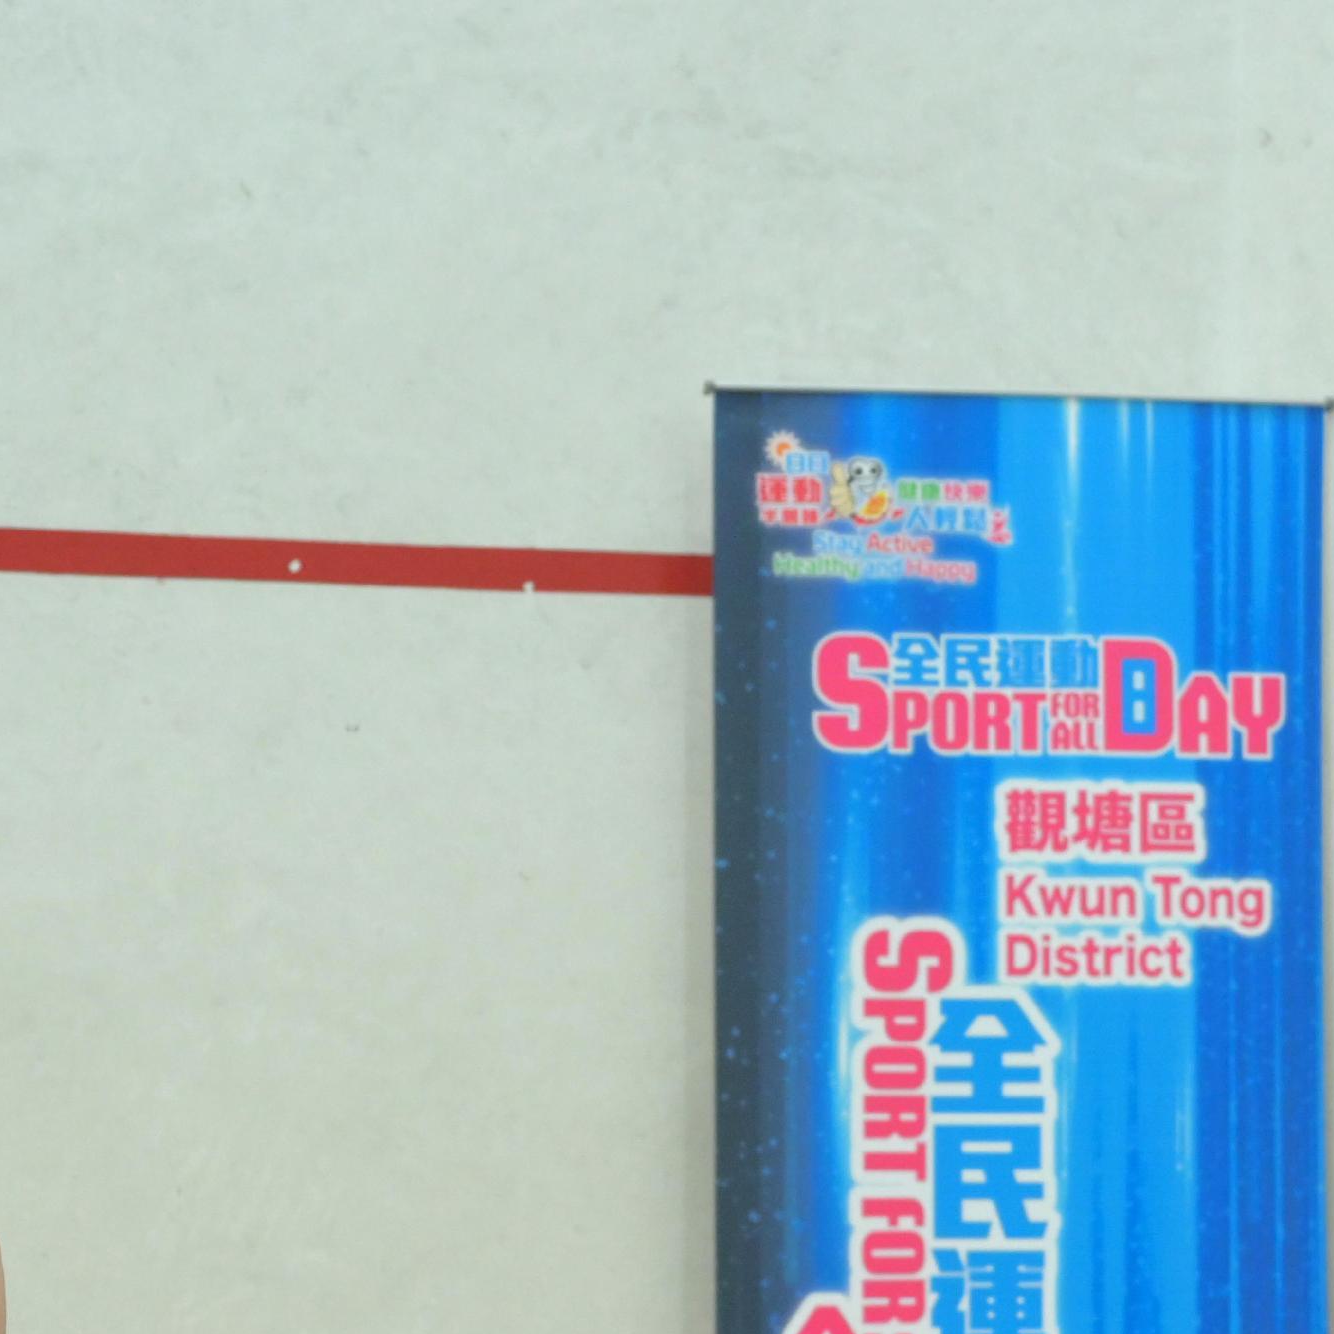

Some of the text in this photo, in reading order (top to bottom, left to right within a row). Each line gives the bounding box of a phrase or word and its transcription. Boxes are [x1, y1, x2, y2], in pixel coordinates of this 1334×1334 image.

[759, 475, 822, 503] 運動
[774, 553, 859, 580] Healthy
[906, 559, 976, 583] Happy
[869, 532, 933, 554] Active
[892, 637, 1098, 687] 全民運動
[815, 634, 1282, 756] SPORT FOR ALL DAY
[1005, 790, 1196, 854] 觀塘區
[1005, 874, 1266, 927] Kwun Tong
[1005, 934, 1185, 979] District
[861, 929, 955, 1325] SPORT FOR
